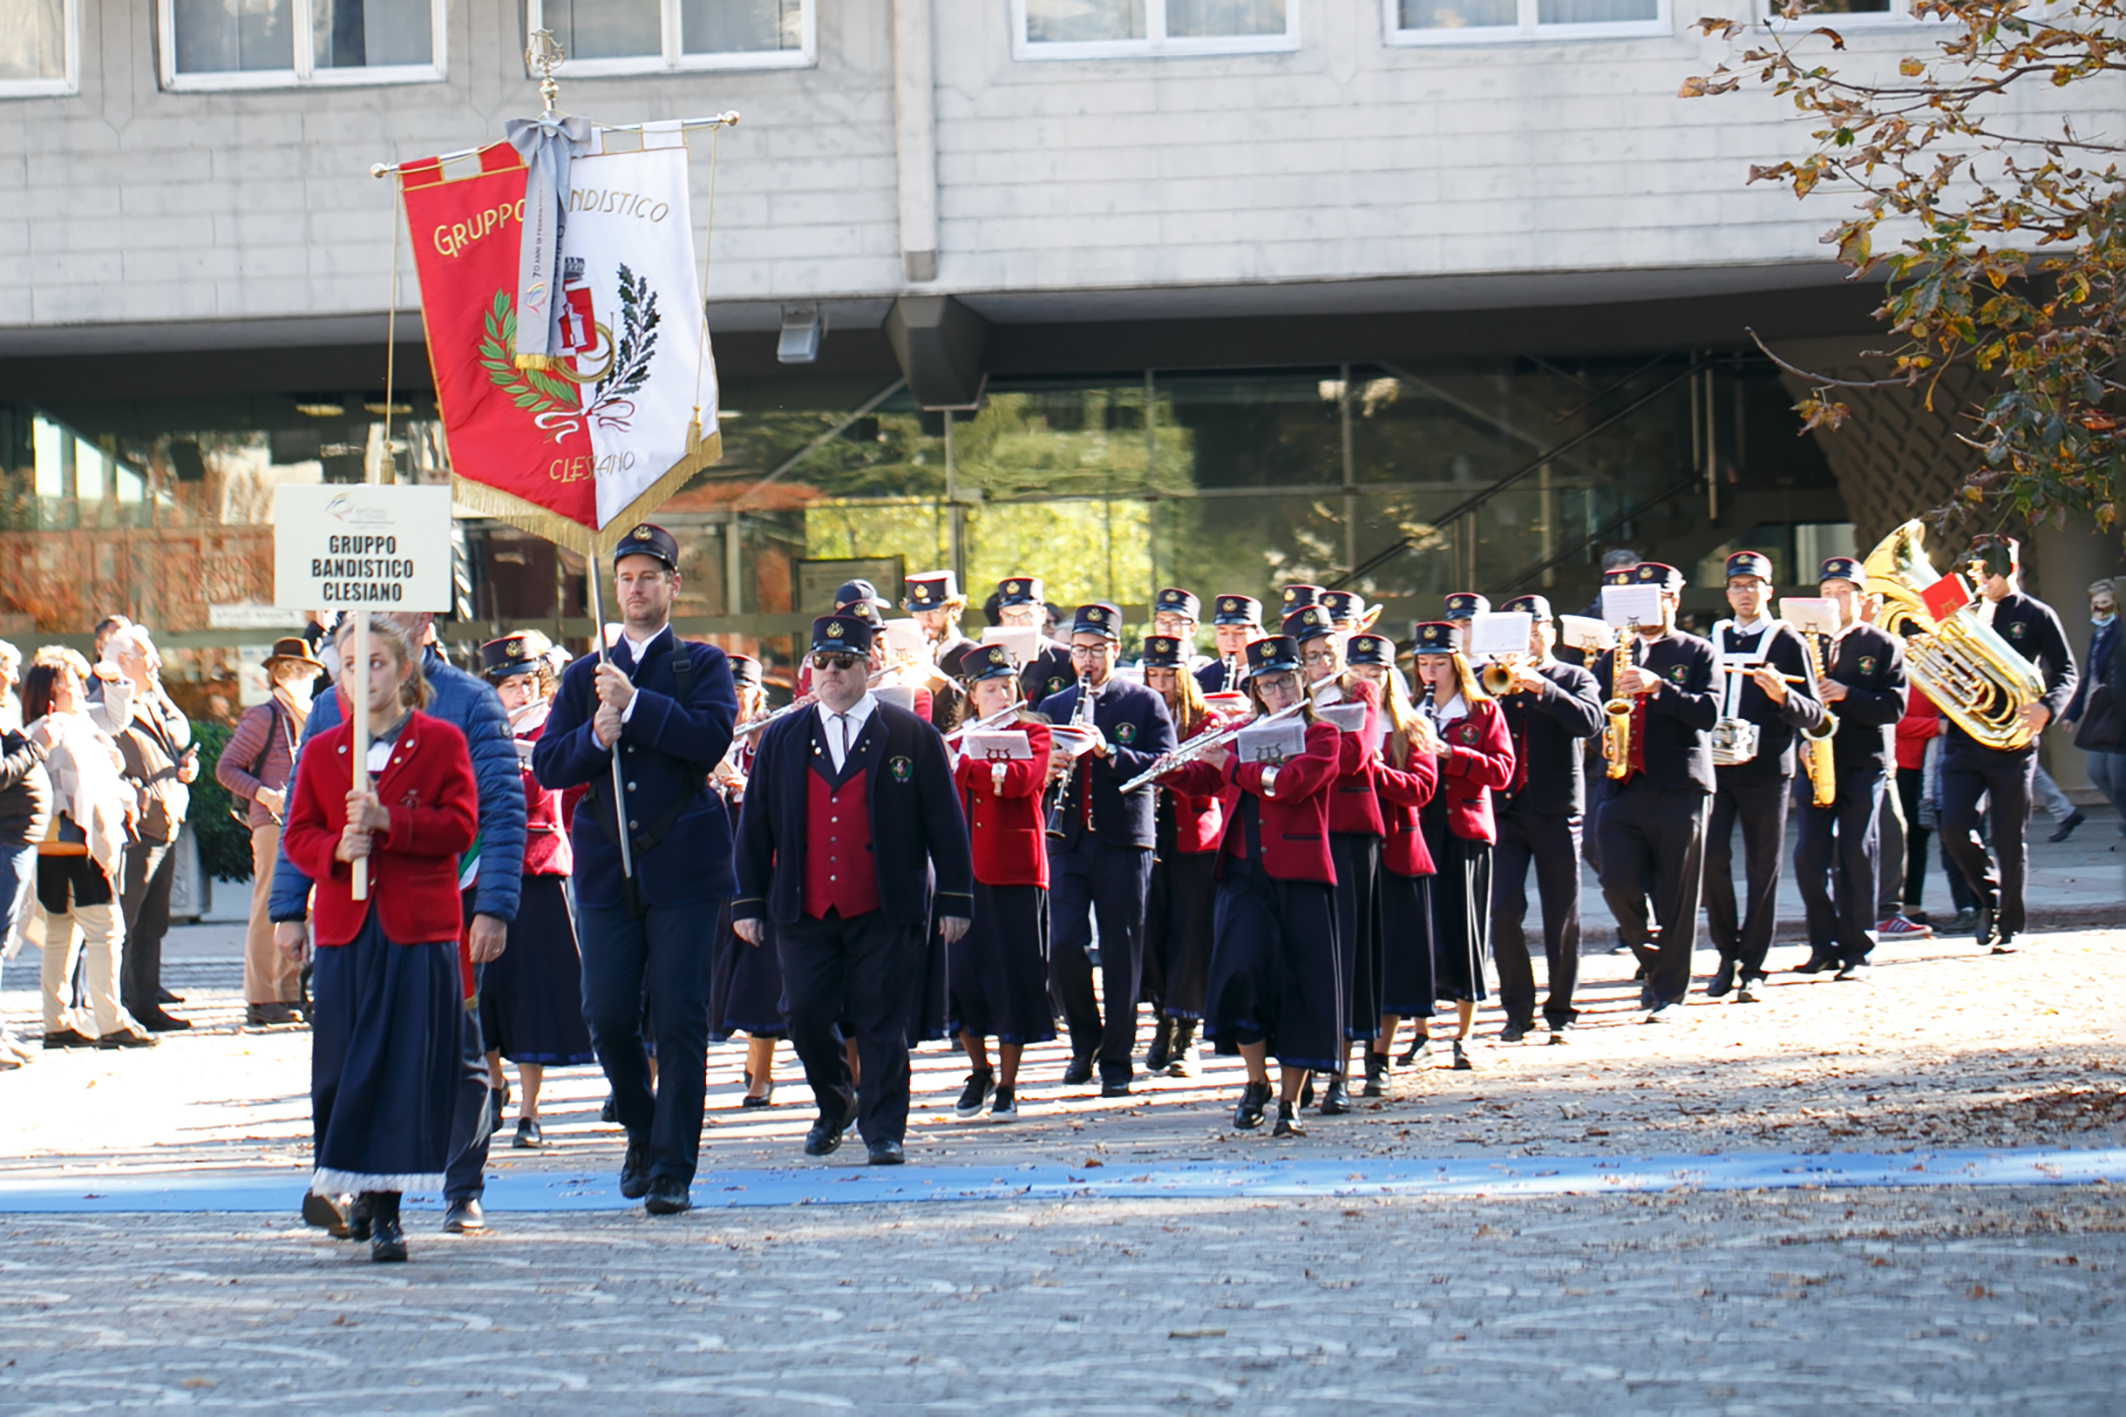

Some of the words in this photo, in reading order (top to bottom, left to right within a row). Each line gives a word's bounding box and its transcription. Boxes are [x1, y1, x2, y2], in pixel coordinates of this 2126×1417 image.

[434, 198, 525, 258] GRUPPO
[569, 188, 669, 223] NDISTICO
[532, 264, 542, 278] 70
[548, 450, 636, 484] CLESIANO
[329, 535, 397, 555] GRUPPO
[311, 558, 414, 578] BANDISTICO
[323, 582, 403, 602] CLESIANO
